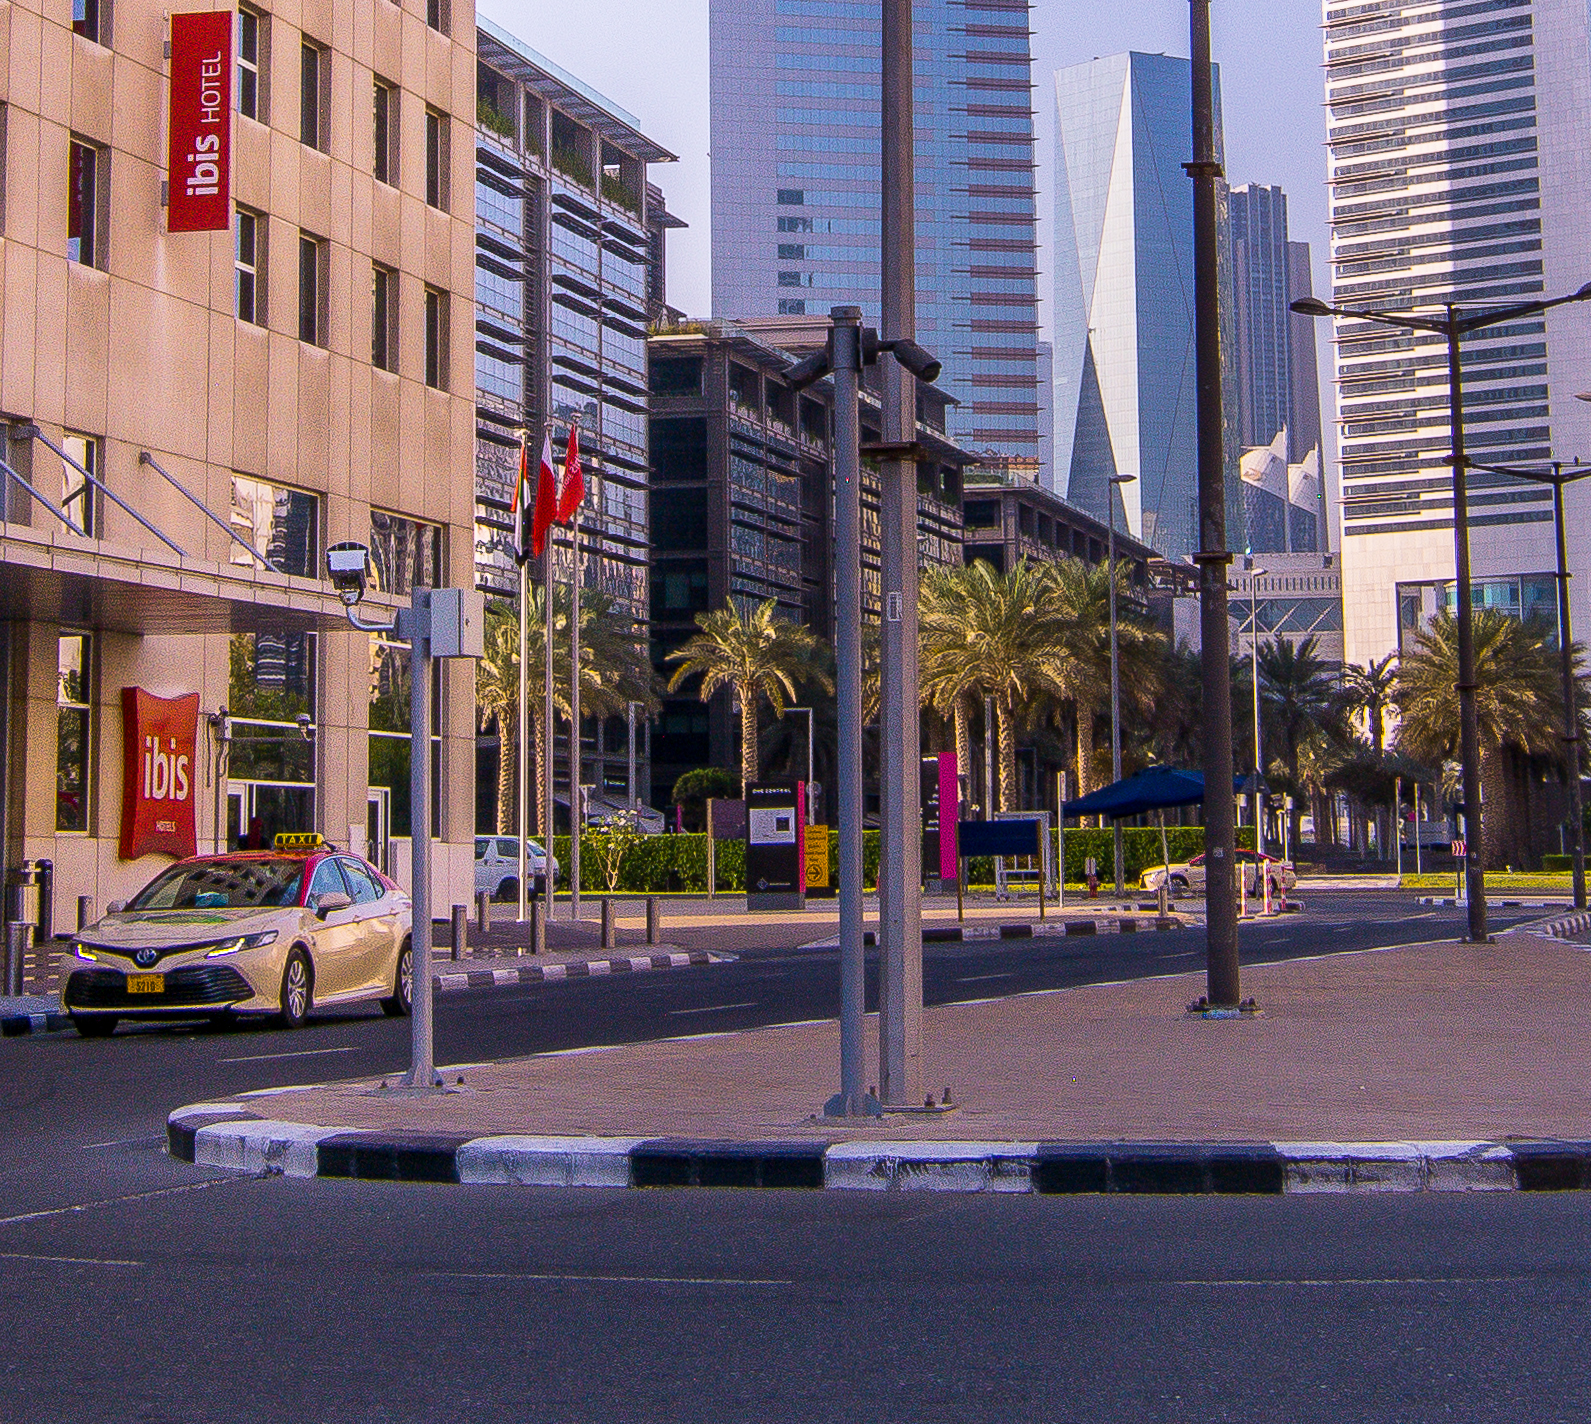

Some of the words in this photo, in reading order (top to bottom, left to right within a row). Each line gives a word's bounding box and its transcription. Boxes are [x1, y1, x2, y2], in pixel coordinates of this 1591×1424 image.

[201, 50, 222, 123] HOTEL
[186, 133, 220, 196] ibis
[144, 735, 188, 801] ibis
[282, 834, 312, 844] TAXI
